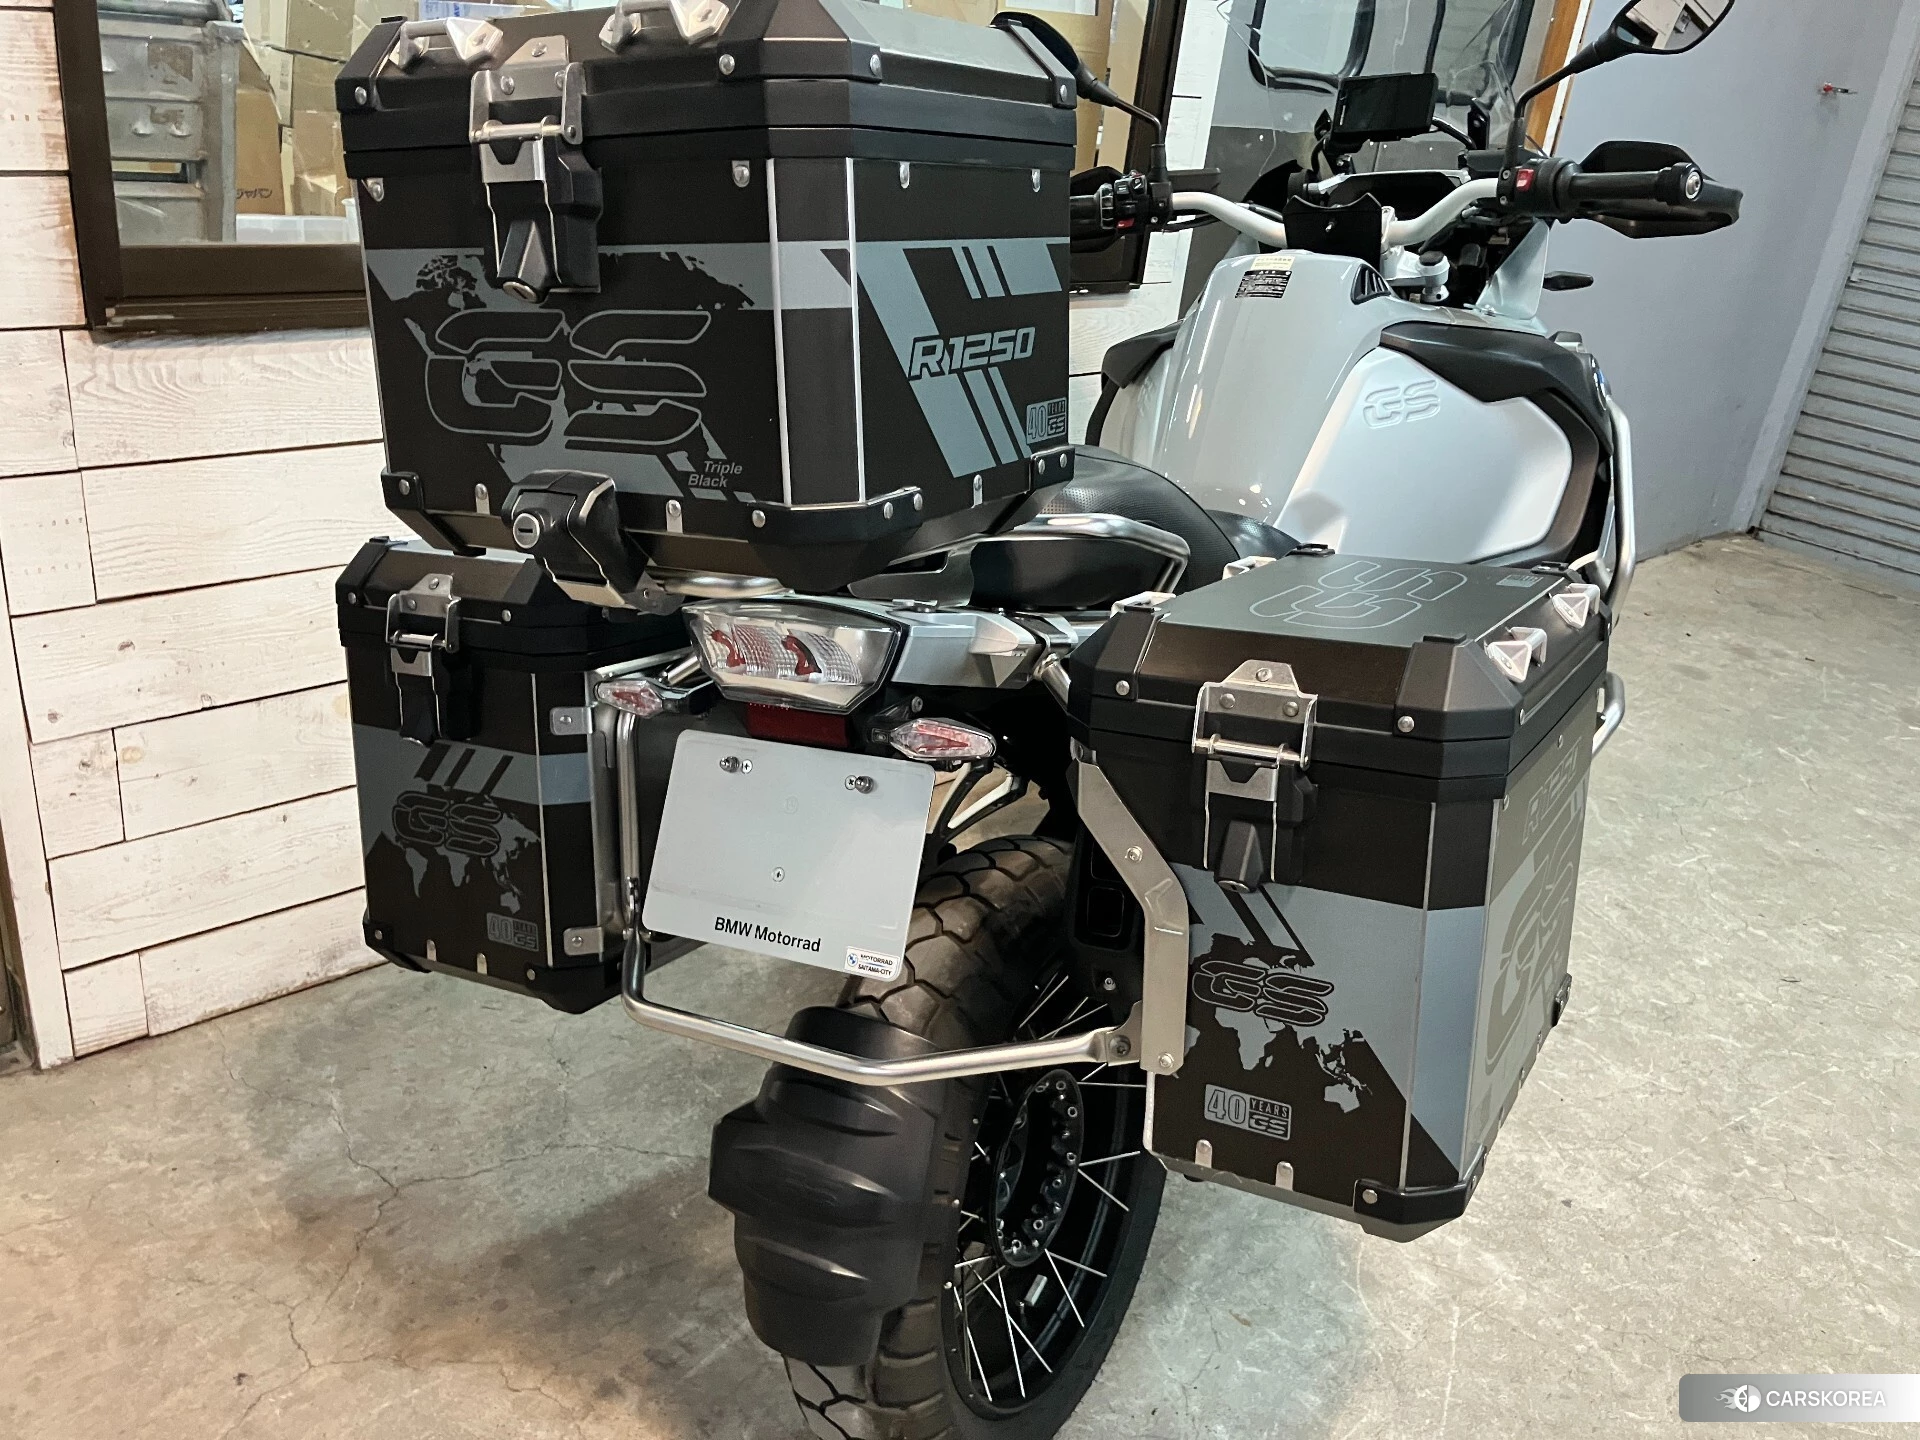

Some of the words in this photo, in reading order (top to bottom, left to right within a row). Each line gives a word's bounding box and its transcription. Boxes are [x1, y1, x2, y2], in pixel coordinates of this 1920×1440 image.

[908, 326, 1036, 378] R1250
[425, 308, 711, 445] GS
[1028, 405, 1047, 439] 40
[1362, 379, 1440, 429] GS
[688, 474, 728, 488] Black
[704, 460, 743, 476] Triple
[394, 792, 501, 857] GS
[714, 916, 753, 937] BMW
[754, 924, 822, 953] Motorrad
[1192, 960, 1334, 1027] GS
[1207, 1089, 1247, 1124] 40
[1250, 1099, 1289, 1118] YEARS
[1250, 1113, 1288, 1136] GS
